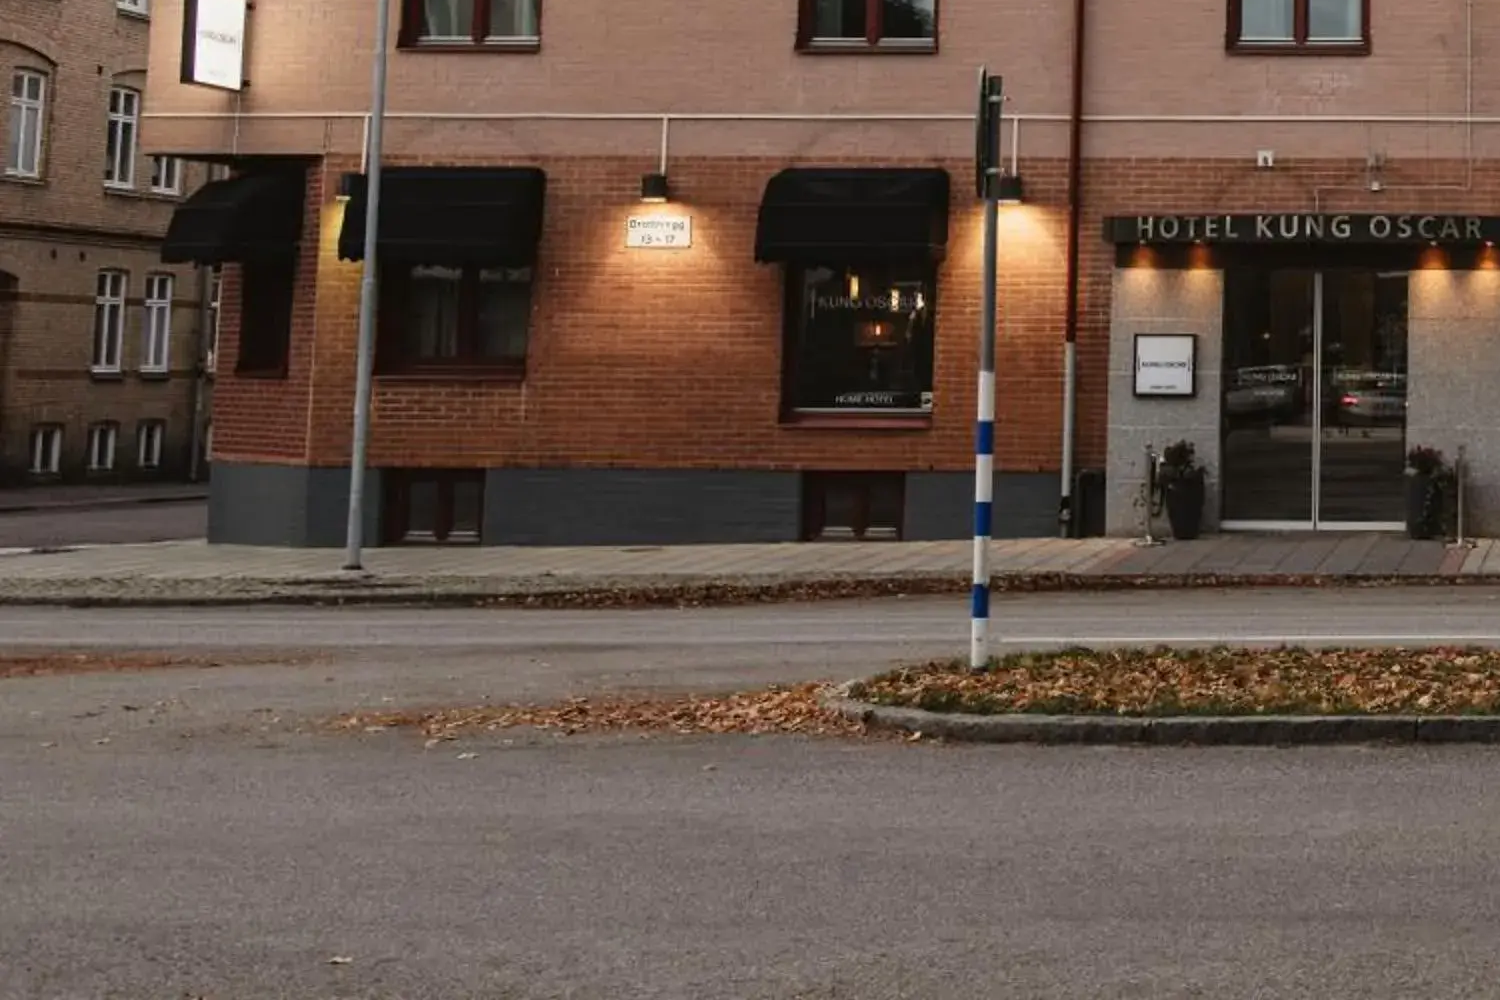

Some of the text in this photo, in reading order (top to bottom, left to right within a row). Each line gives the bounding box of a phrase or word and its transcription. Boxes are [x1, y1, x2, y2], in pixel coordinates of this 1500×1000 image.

[1136, 215, 1482, 239] HOTEL KUNG OSCAR
